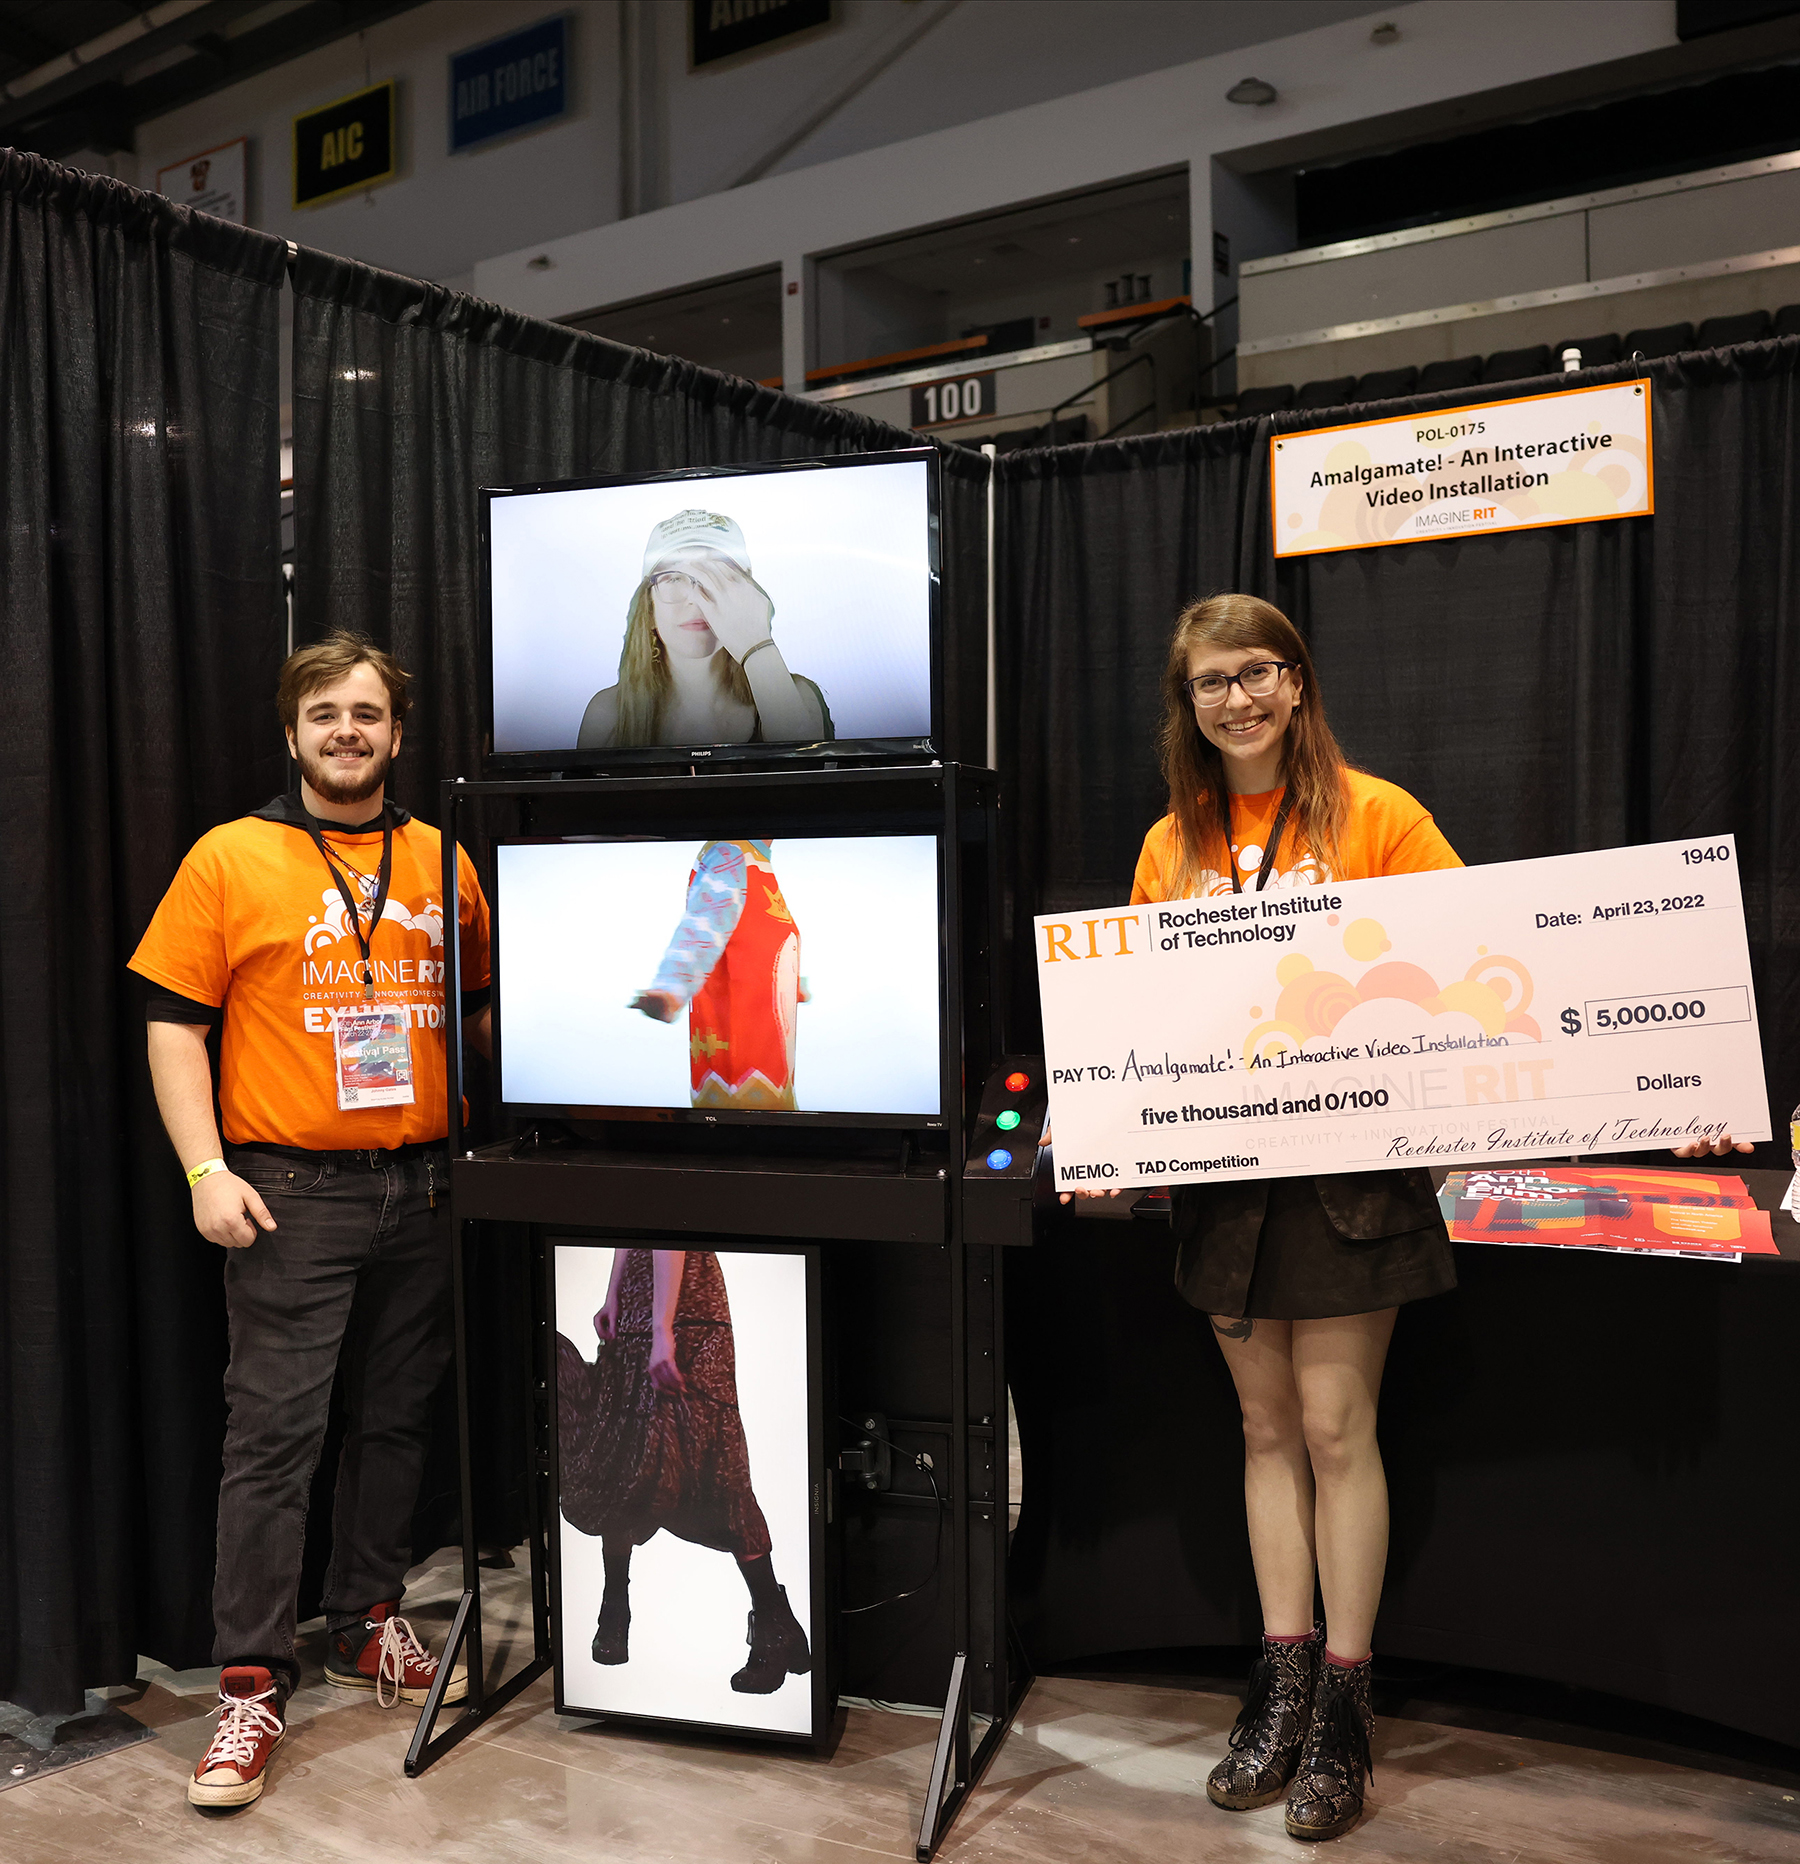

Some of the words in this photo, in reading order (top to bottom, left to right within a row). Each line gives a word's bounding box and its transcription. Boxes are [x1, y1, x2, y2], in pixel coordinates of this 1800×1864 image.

[456, 73, 490, 120] AIR
[494, 47, 559, 106] FORCE
[320, 121, 364, 171] AIC
[924, 378, 982, 422] 100
[1416, 421, 1486, 443] POL-0175
[1310, 454, 1443, 488] Amalgamate!
[1460, 448, 1488, 468] An
[1494, 431, 1613, 463] Interactive
[1366, 485, 1424, 508] Video
[1429, 470, 1549, 500] Installation
[1415, 509, 1471, 528] IMAGINE
[1473, 506, 1497, 521] RIT
[691, 750, 712, 758] PHILIPS
[1681, 845, 1731, 865] 1940
[1158, 905, 1258, 929] Rochester
[1262, 894, 1343, 919] Institute
[1535, 911, 1583, 929] Date:
[1592, 902, 1630, 921] April
[1632, 900, 1659, 915] 23,
[1660, 894, 1706, 912] 2022
[1041, 914, 1141, 964] RIT
[1160, 930, 1180, 951] of
[1183, 922, 1297, 949] Technology
[302, 959, 416, 986] IMAGINE
[303, 991, 361, 1001] CREATIVITY
[375, 988, 423, 998] NNOVATION
[1560, 1006, 1583, 1037] $
[1596, 1000, 1707, 1031] 5,000.00
[343, 1046, 380, 1057] Festival
[382, 1046, 406, 1055] Pass
[1121, 1048, 1234, 1083] Amalgamate!
[1249, 1052, 1272, 1069] An
[1275, 1045, 1360, 1069] Interactive
[1364, 1038, 1411, 1059] Video
[1412, 1033, 1510, 1055] Installation
[1053, 1067, 1084, 1084] PAY
[1087, 1065, 1116, 1082] TO:
[1462, 1058, 1555, 1107] RIT
[1636, 1073, 1703, 1092] Dollars
[1141, 1107, 1178, 1126] five
[1181, 1097, 1278, 1122] thousand
[1281, 1094, 1321, 1115] and
[1324, 1088, 1389, 1112] 0/100
[1386, 1136, 1477, 1158] Rochester
[1486, 1128, 1575, 1151] Institute
[1578, 1122, 1608, 1151] of
[1611, 1115, 1729, 1142] Technology
[1061, 1162, 1120, 1181] MEMO:
[1136, 1160, 1167, 1175] TAD
[1169, 1154, 1260, 1173] Competition
